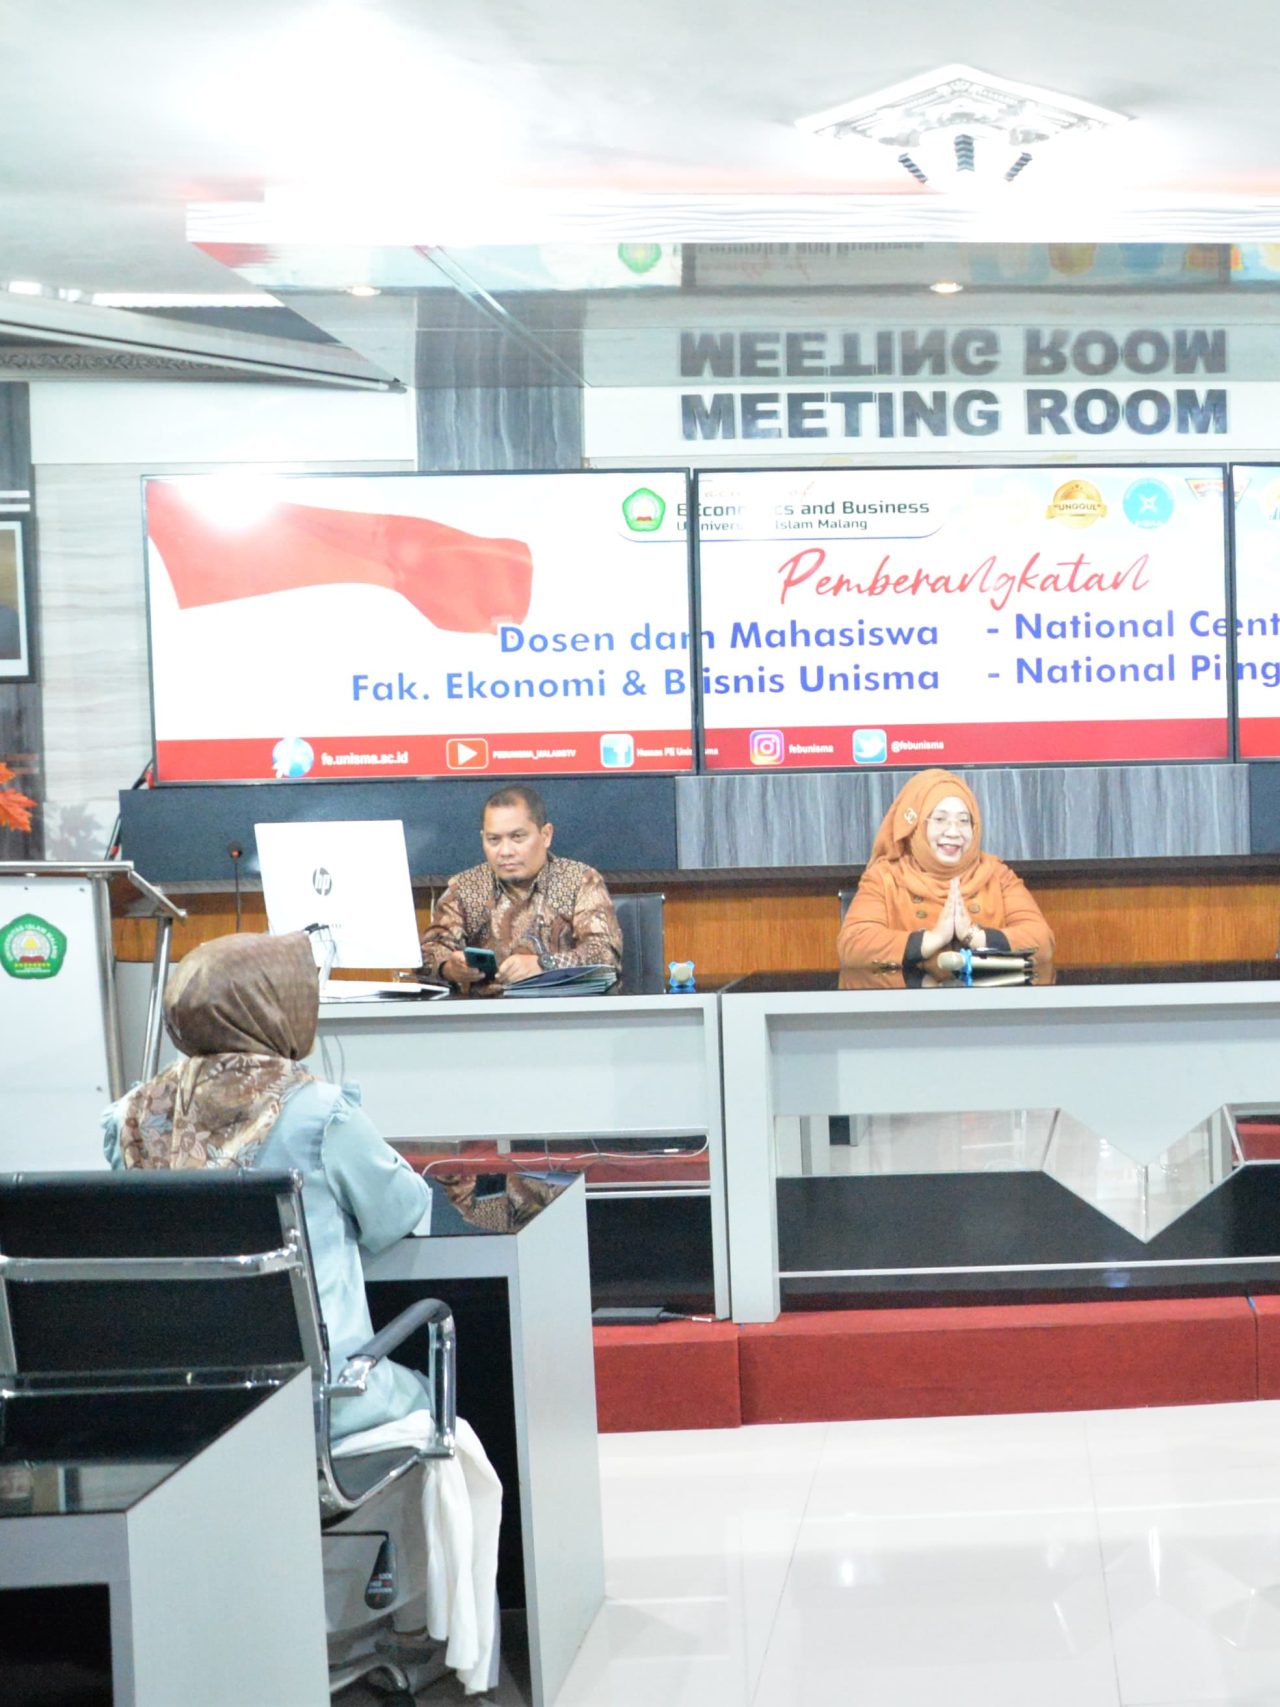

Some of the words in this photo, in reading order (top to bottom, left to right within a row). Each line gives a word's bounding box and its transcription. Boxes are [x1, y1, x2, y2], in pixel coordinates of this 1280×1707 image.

[681, 388, 999, 440] MEETING
[1026, 388, 1228, 436] ROOM
[800, 500, 836, 516] and
[842, 499, 930, 515] Business
[775, 519, 814, 530] Islam
[818, 518, 868, 531] Malang
[778, 547, 1151, 612] Pemberangkatan
[499, 626, 616, 653] Dosen
[630, 622, 715, 651] dan
[730, 619, 939, 649] Mahasiswa
[1015, 610, 1175, 640] National
[351, 672, 430, 702] Fak.
[446, 669, 606, 700] Ekonomi
[622, 670, 647, 697] &
[664, 666, 785, 696] Bisnis
[799, 663, 940, 693] Unisma
[1016, 654, 1176, 685] National
